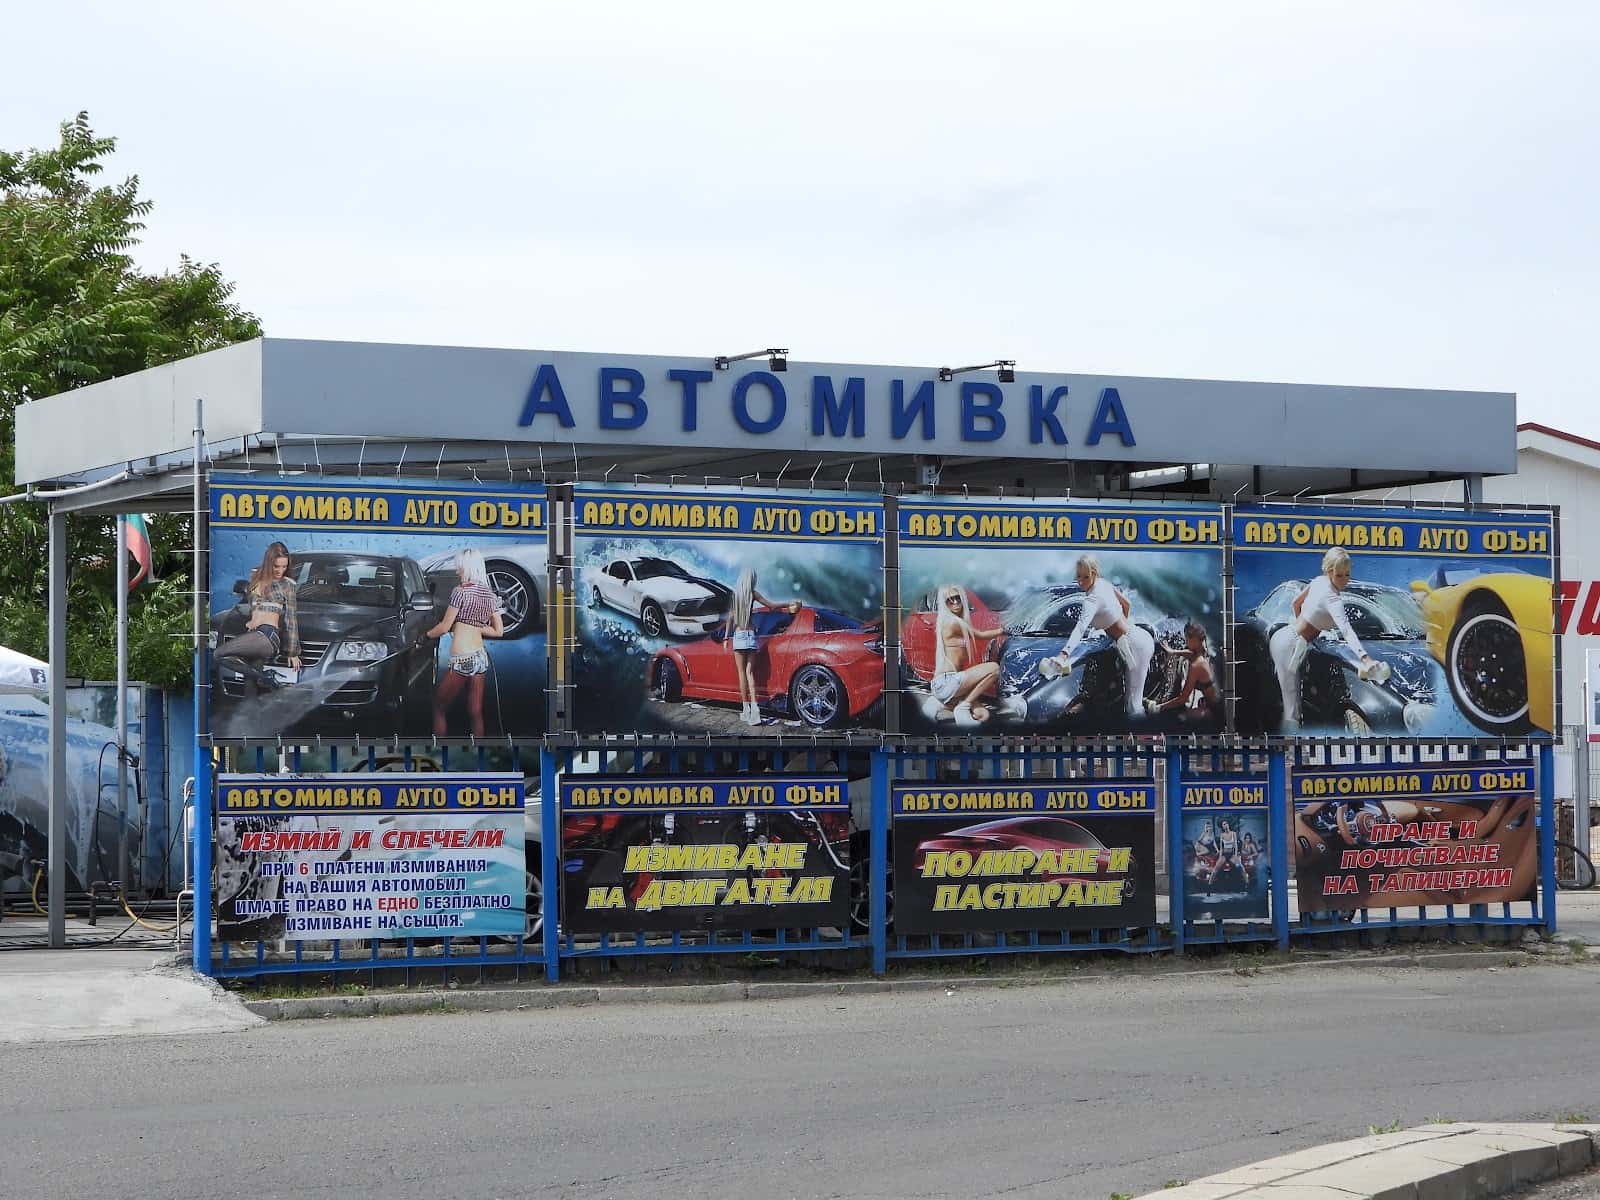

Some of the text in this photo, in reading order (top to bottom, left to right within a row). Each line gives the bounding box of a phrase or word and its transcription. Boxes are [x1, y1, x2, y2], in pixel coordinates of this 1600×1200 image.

[518, 363, 1137, 447] АВТОМИВКА
[219, 493, 542, 527] АВТОМИВКА АУТО ФЪН
[583, 501, 875, 534] АВТОМИВКА АУТО ФЪН
[908, 513, 1218, 542] АВТОМИВКА АУТО ФЪН
[1245, 521, 1547, 552] АВТОМИВКА АУТО ФЪН
[571, 784, 840, 806] АВТОМИВКА АУТО ФЪН
[1184, 787, 1264, 806] АУТО ФЪН
[1301, 771, 1526, 796] АВТОМИВКА АУТО ФЪН
[227, 787, 516, 808] АВТОМИВКА АУТО ФЪН
[902, 790, 1146, 811] АВТОМИВКА АУТО ФЪН
[240, 826, 505, 852] ИЗМИЙ И СПЕЧЕЛИ
[1369, 820, 1477, 844] ПРАНЕ И
[262, 859, 487, 876] ПРИ 6 ПЛАТЕНИ ИЗМИВАНИЯ
[622, 842, 808, 873] ИЗМИВАНЕ
[921, 846, 1132, 878] ПОЛИРАНЕ И
[1340, 844, 1500, 871] ПОЧИСТВАНЕ
[284, 877, 466, 894] НА ВАШИЯ АВТОМОБИЛ
[585, 876, 835, 911] НА ДВИГАТЕЛЯ
[932, 880, 1126, 911] ПАСТИРАНЕ
[1322, 868, 1514, 897] НА ТАПИЦЕРИИ
[236, 894, 511, 914] ИМАТЕ ПРАВО НА ЕДНО БЕЗПЛАТНО
[286, 913, 464, 931] ИЗМИВАНЕ НА СЪЩИЯ.
